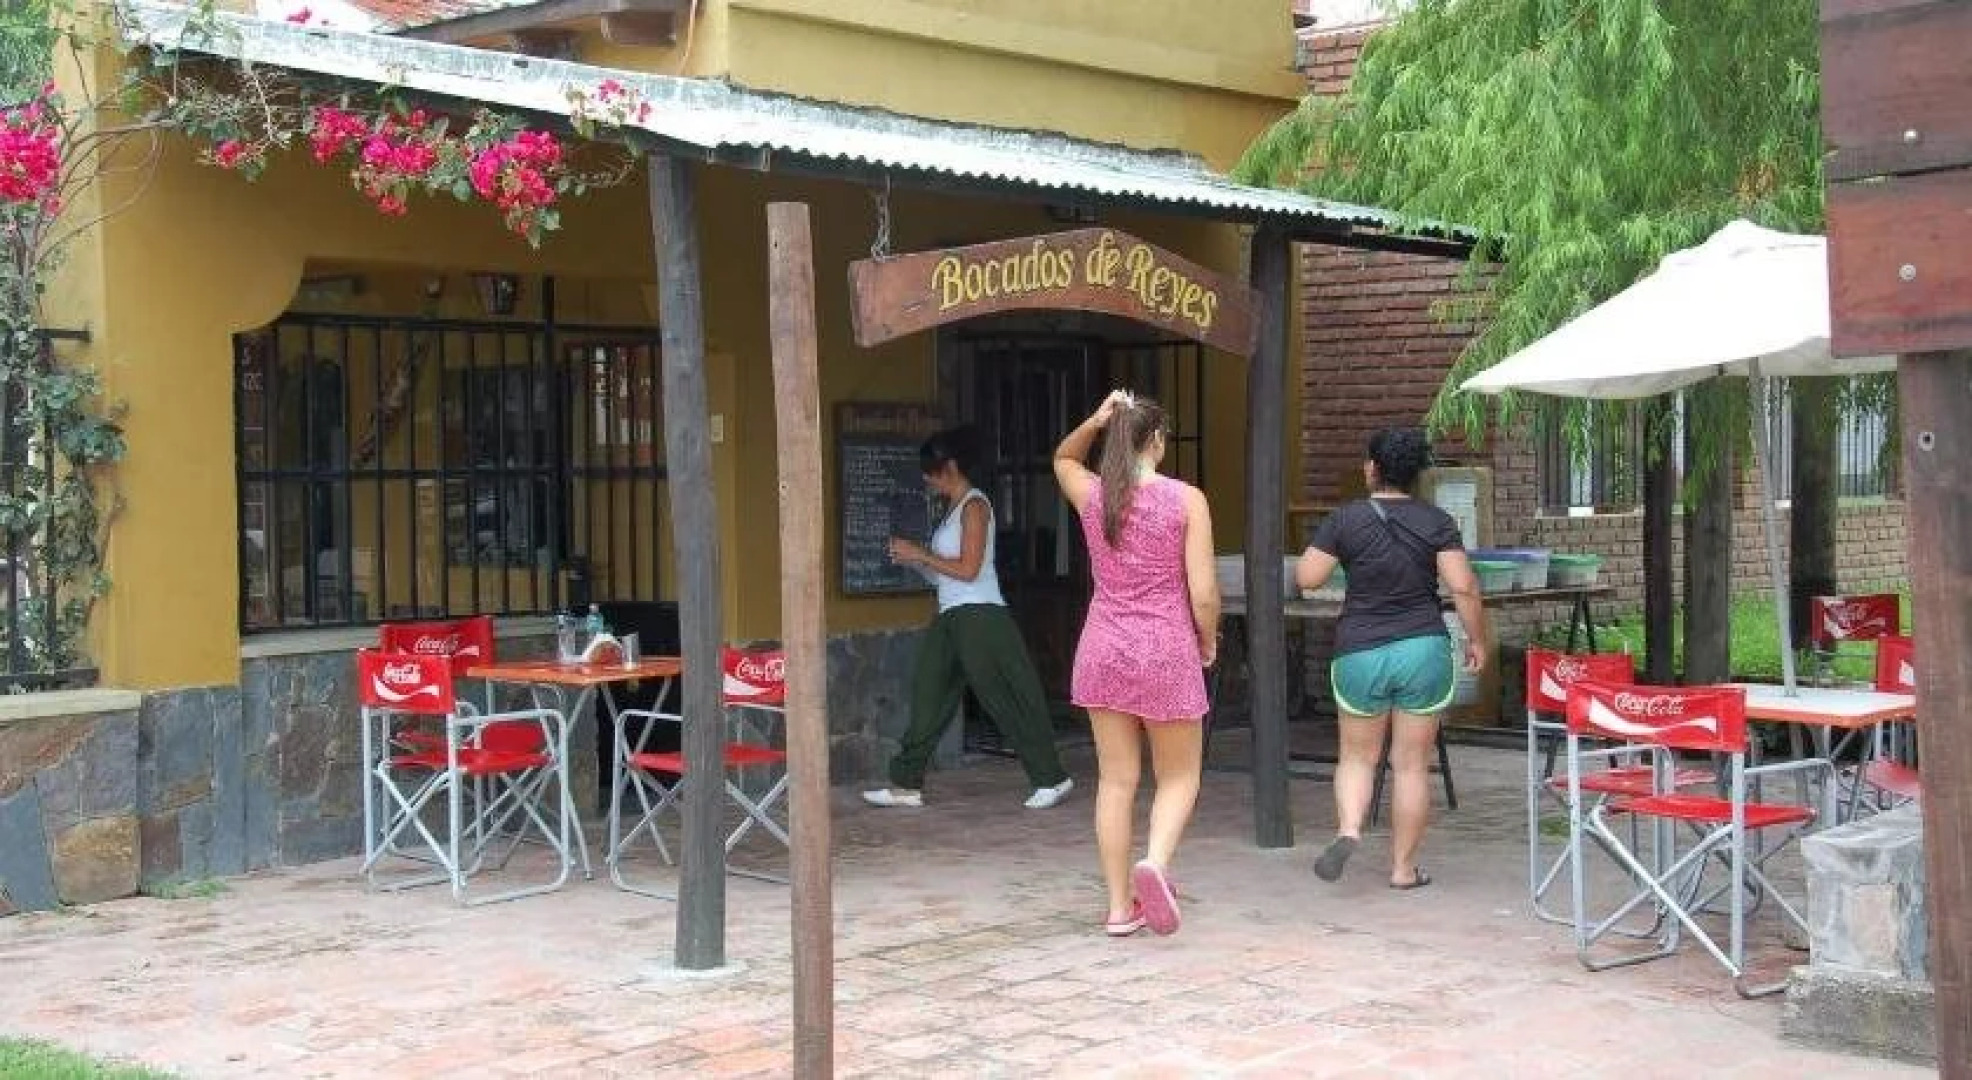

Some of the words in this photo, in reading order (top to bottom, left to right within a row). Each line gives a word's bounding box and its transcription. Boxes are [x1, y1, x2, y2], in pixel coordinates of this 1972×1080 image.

[932, 239, 1073, 311] Bocados
[1086, 232, 1122, 286] de
[1126, 243, 1218, 328] Reyes
